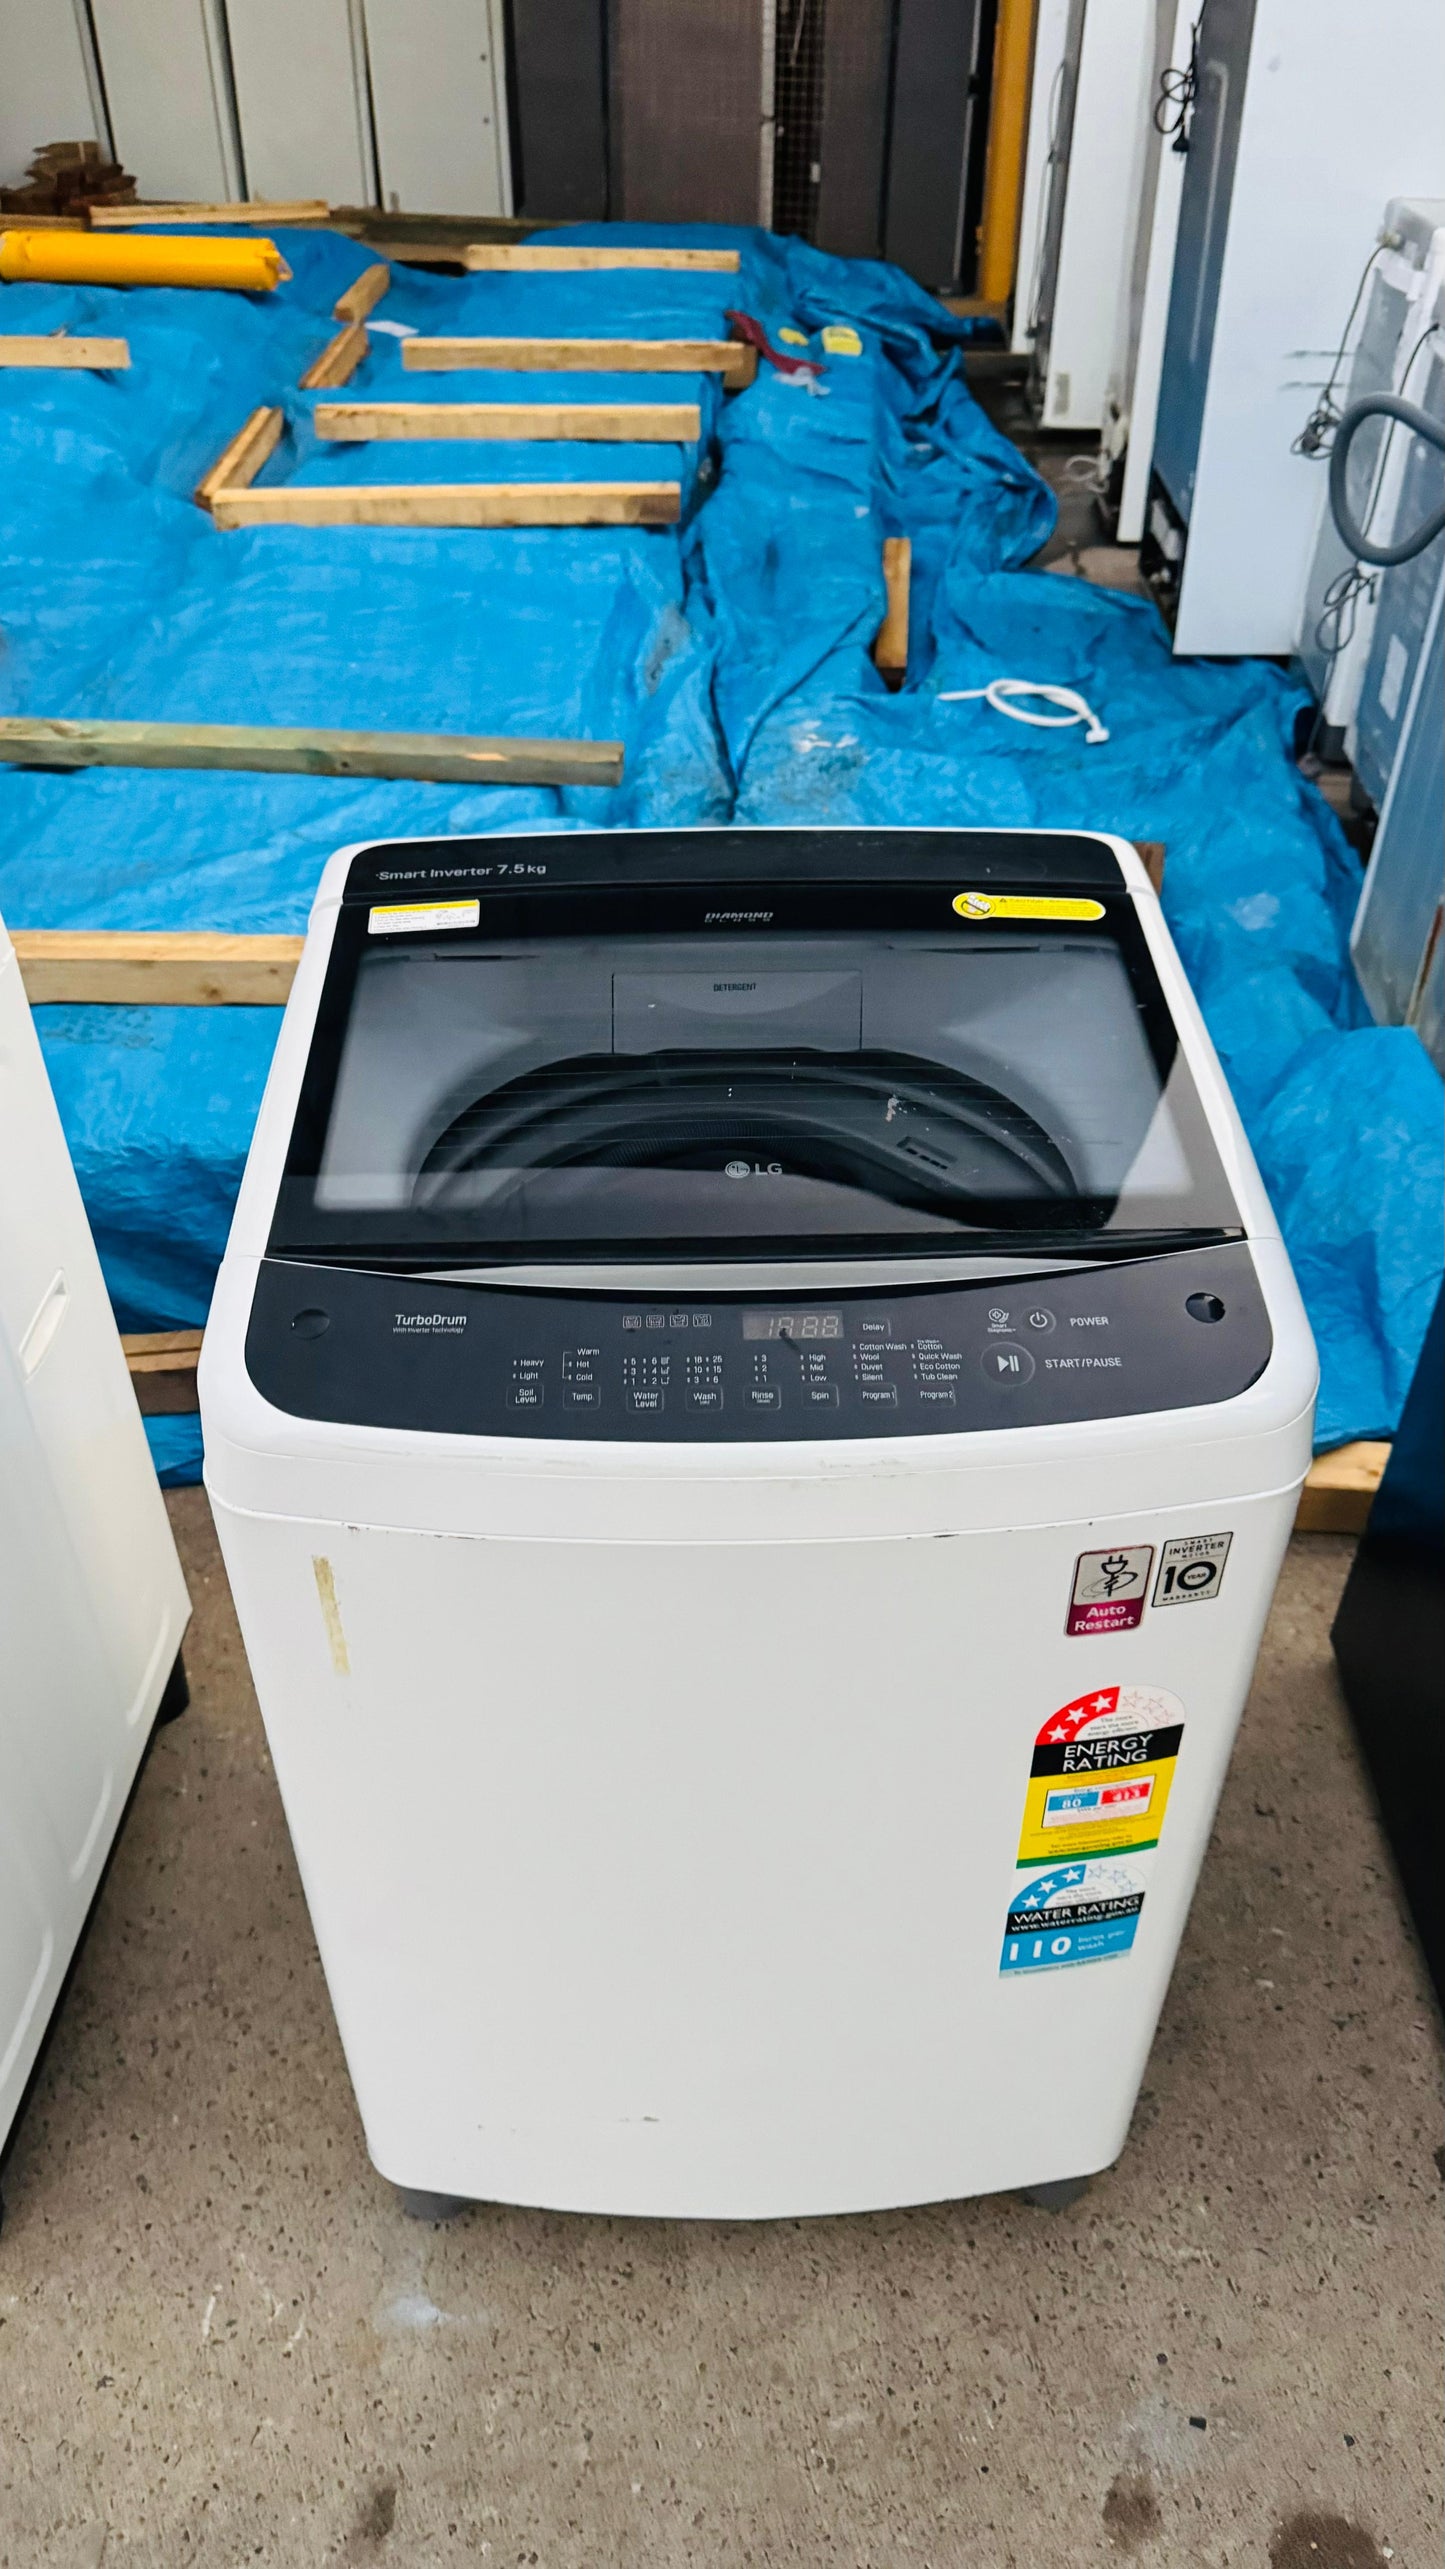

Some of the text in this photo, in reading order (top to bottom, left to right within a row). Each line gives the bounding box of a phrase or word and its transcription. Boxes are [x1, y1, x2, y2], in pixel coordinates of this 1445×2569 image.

[379, 869, 427, 880] Smart
[430, 866, 493, 878] Inverter
[705, 911, 774, 919] DIAMOND
[713, 982, 757, 992] DETERGENT
[754, 1162, 783, 1176] LG
[395, 1314, 467, 1326] TurboDrum
[1069, 1316, 1109, 1327] POWER
[862, 1323, 885, 1332] Delay
[860, 1343, 884, 1351] Cotton
[762, 1354, 767, 1362] 3
[809, 1354, 826, 1362] High
[918, 1352, 962, 1360] Quick Wash
[520, 1359, 545, 1368] Heavy
[576, 1360, 590, 1368] Hot
[920, 1362, 961, 1370] Eco Cotton
[1045, 1357, 1122, 1369] START/PAUSE
[630, 1367, 658, 1375] 3 4
[694, 1366, 722, 1374] 10 15
[762, 1364, 768, 1372] 2
[810, 1364, 824, 1372] Mid
[519, 1372, 539, 1381] Light
[576, 1373, 593, 1381] Cold
[694, 1376, 700, 1384] 3
[810, 1374, 827, 1382] Low
[862, 1373, 884, 1381] Silent
[921, 1372, 958, 1380] Tub Clean
[652, 1377, 658, 1385] 2
[519, 1388, 534, 1396] Soil
[633, 1391, 659, 1400] Water
[752, 1391, 774, 1399] Rinse
[811, 1391, 830, 1400] Spin
[862, 1392, 890, 1400] Program
[920, 1391, 948, 1400] Program
[515, 1396, 537, 1404] Level
[693, 1392, 716, 1401] Wash
[635, 1399, 657, 1408] Level
[1169, 1540, 1225, 1556] INVERTER
[1163, 1560, 1218, 1595] 10
[1186, 1572, 1207, 1580] YEAR
[1086, 1604, 1127, 1618] Auto
[1074, 1616, 1135, 1632] Restart
[1064, 1733, 1154, 1758] ENERGY
[1062, 1749, 1148, 1772] RATING
[1062, 1798, 1082, 1810] 80
[1014, 1906, 1072, 1924] WATER
[1077, 1896, 1140, 1916] RATING
